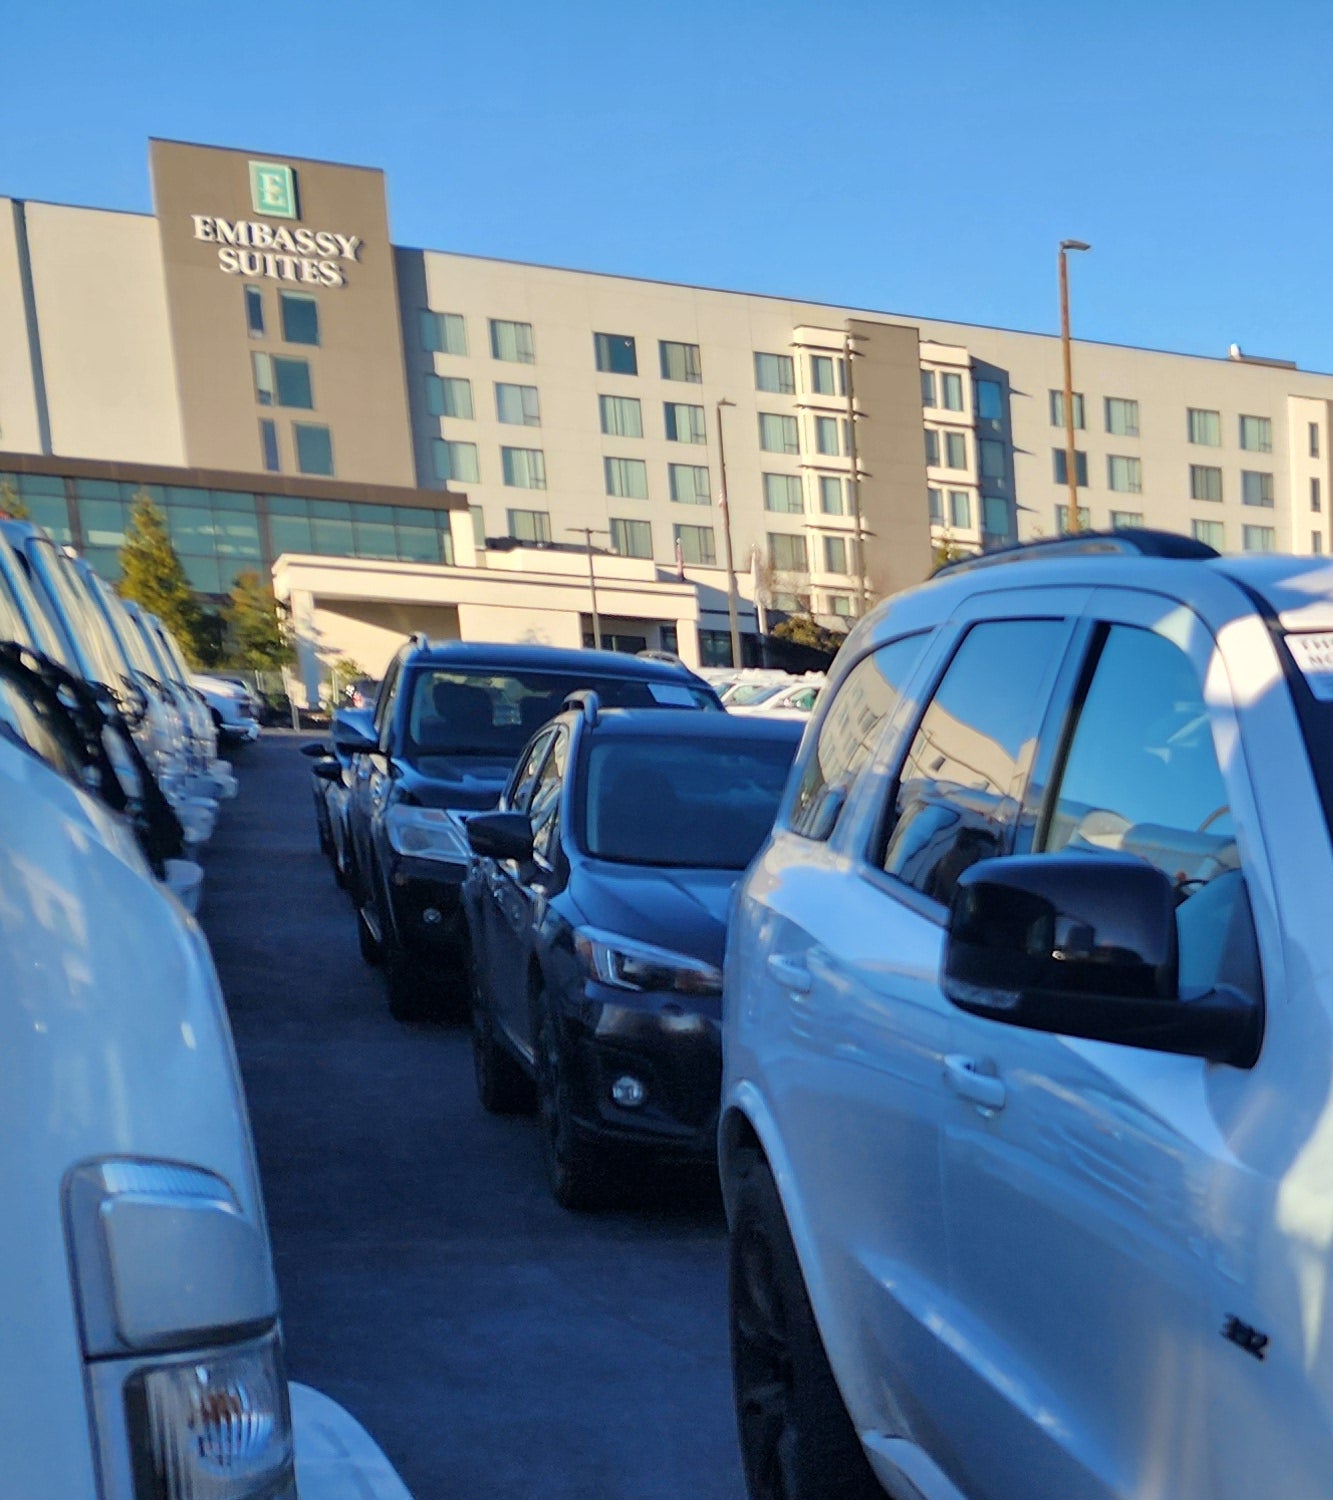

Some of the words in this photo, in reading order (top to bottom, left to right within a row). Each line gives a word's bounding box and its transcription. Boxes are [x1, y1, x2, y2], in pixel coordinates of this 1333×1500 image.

[261, 173, 285, 205] E
[191, 214, 362, 261] EMBASSY
[217, 248, 345, 287] SUITES
